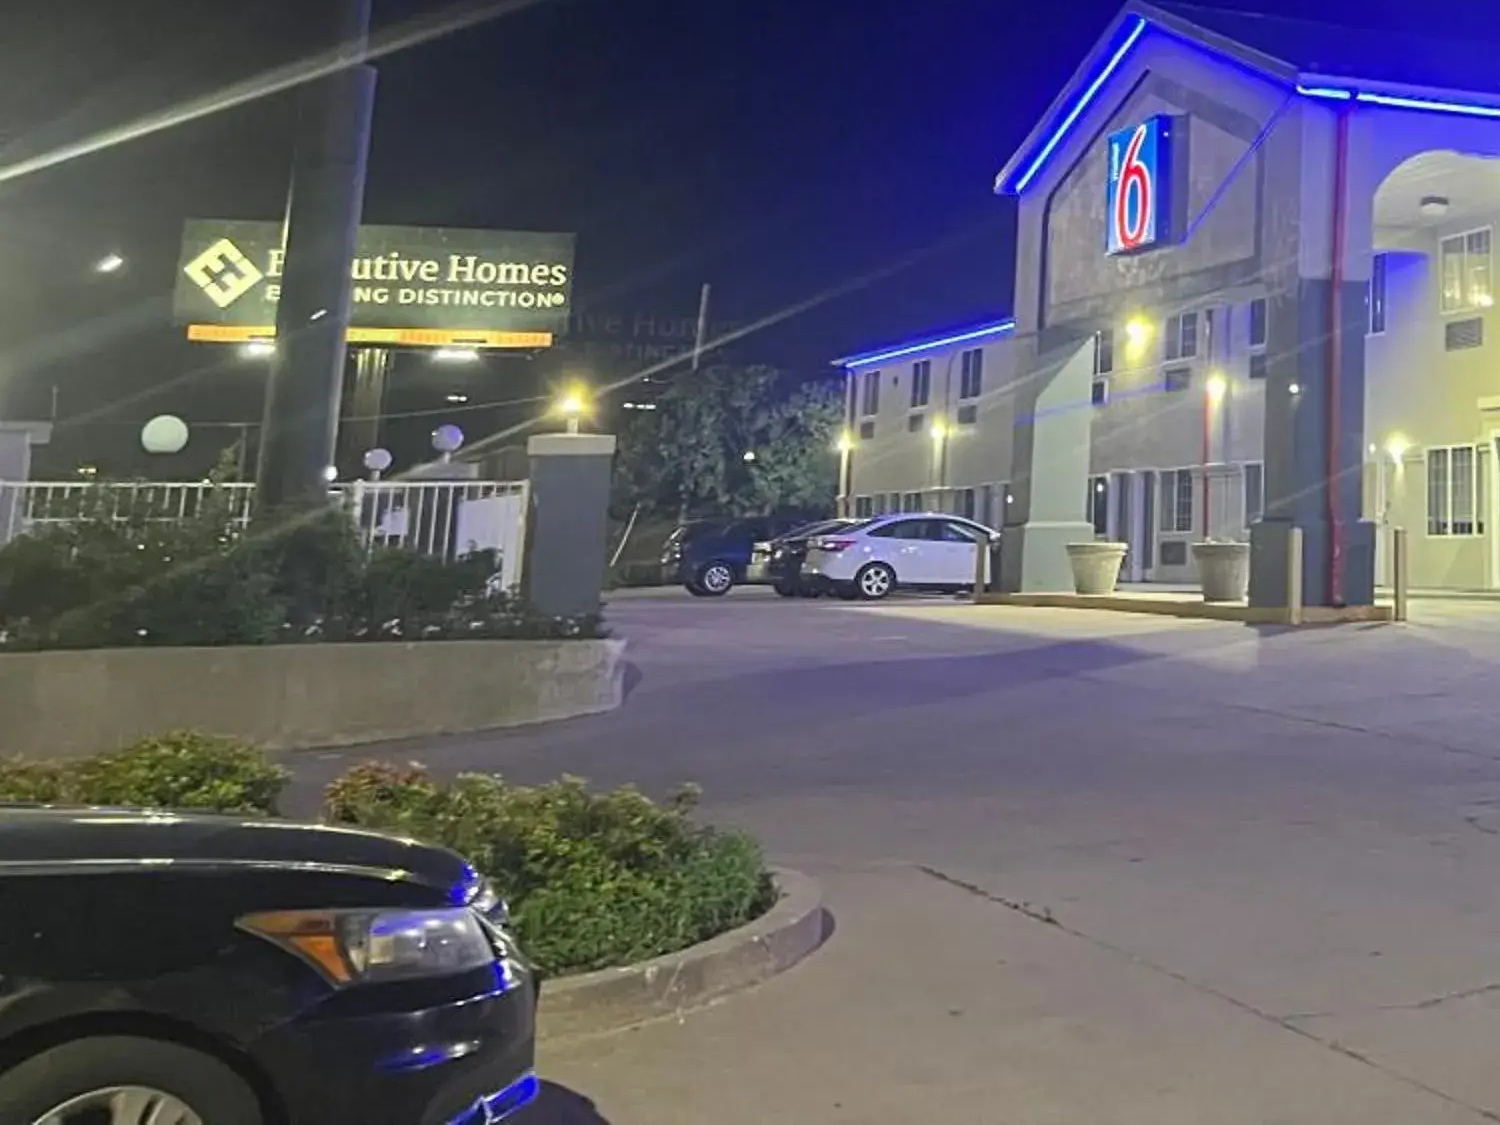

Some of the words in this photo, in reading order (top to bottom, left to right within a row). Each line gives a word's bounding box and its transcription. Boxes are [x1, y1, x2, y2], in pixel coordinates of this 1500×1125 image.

[1116, 124, 1151, 251] 6
[265, 249, 440, 282] Eutive
[447, 254, 567, 286] Homes
